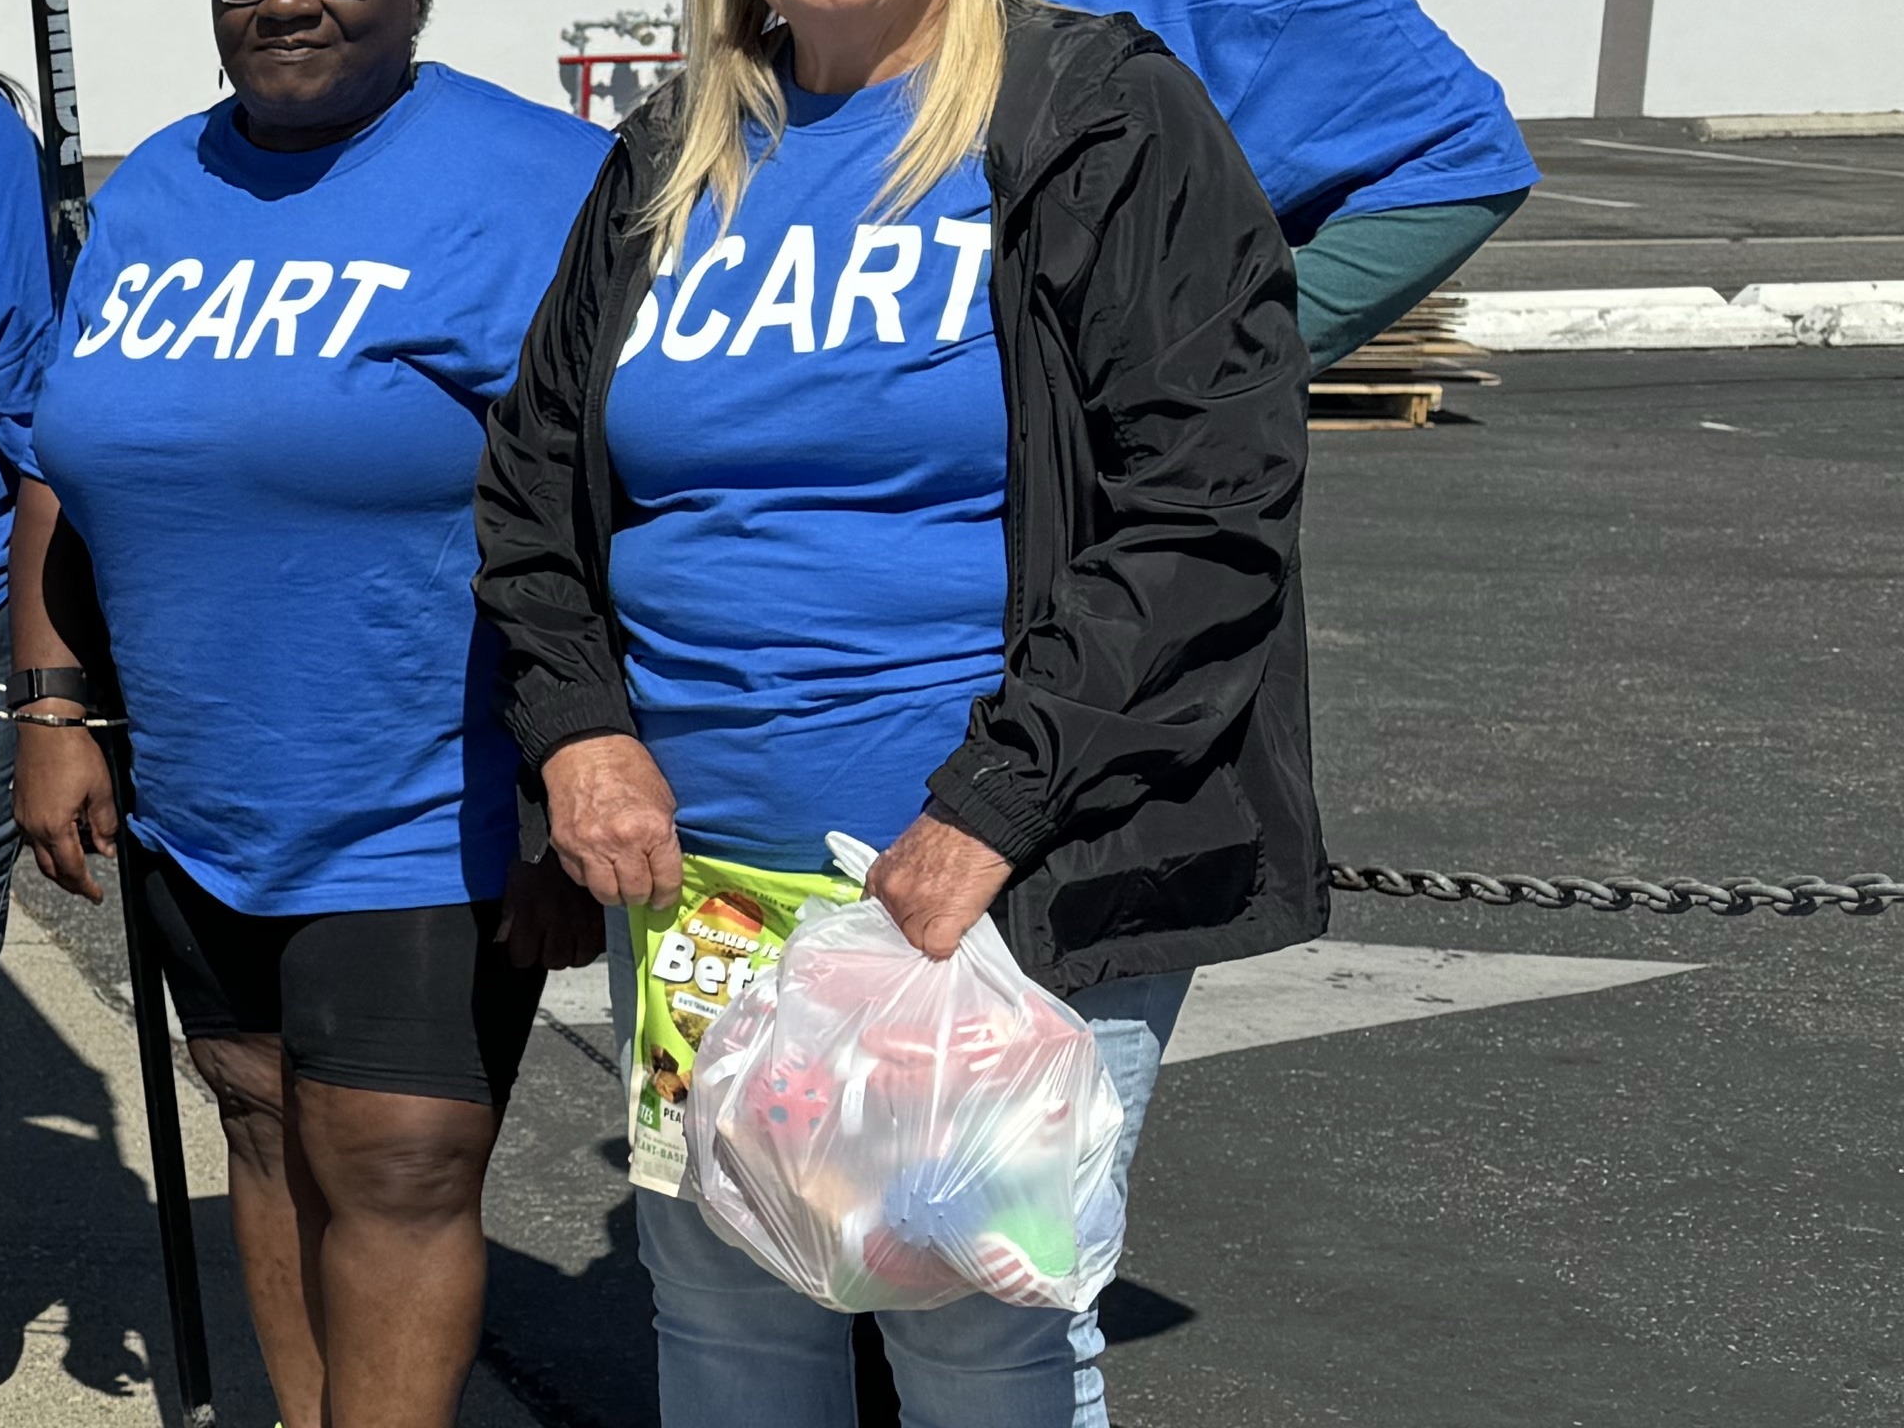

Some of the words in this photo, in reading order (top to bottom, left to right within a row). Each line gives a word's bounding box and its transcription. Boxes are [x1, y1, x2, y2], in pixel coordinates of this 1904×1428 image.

[73, 258, 410, 360] SCART
[616, 215, 991, 369] SCART
[651, 930, 755, 999] Bet
[687, 918, 760, 953] Because
[678, 996, 723, 1015] SUSTAINABL
